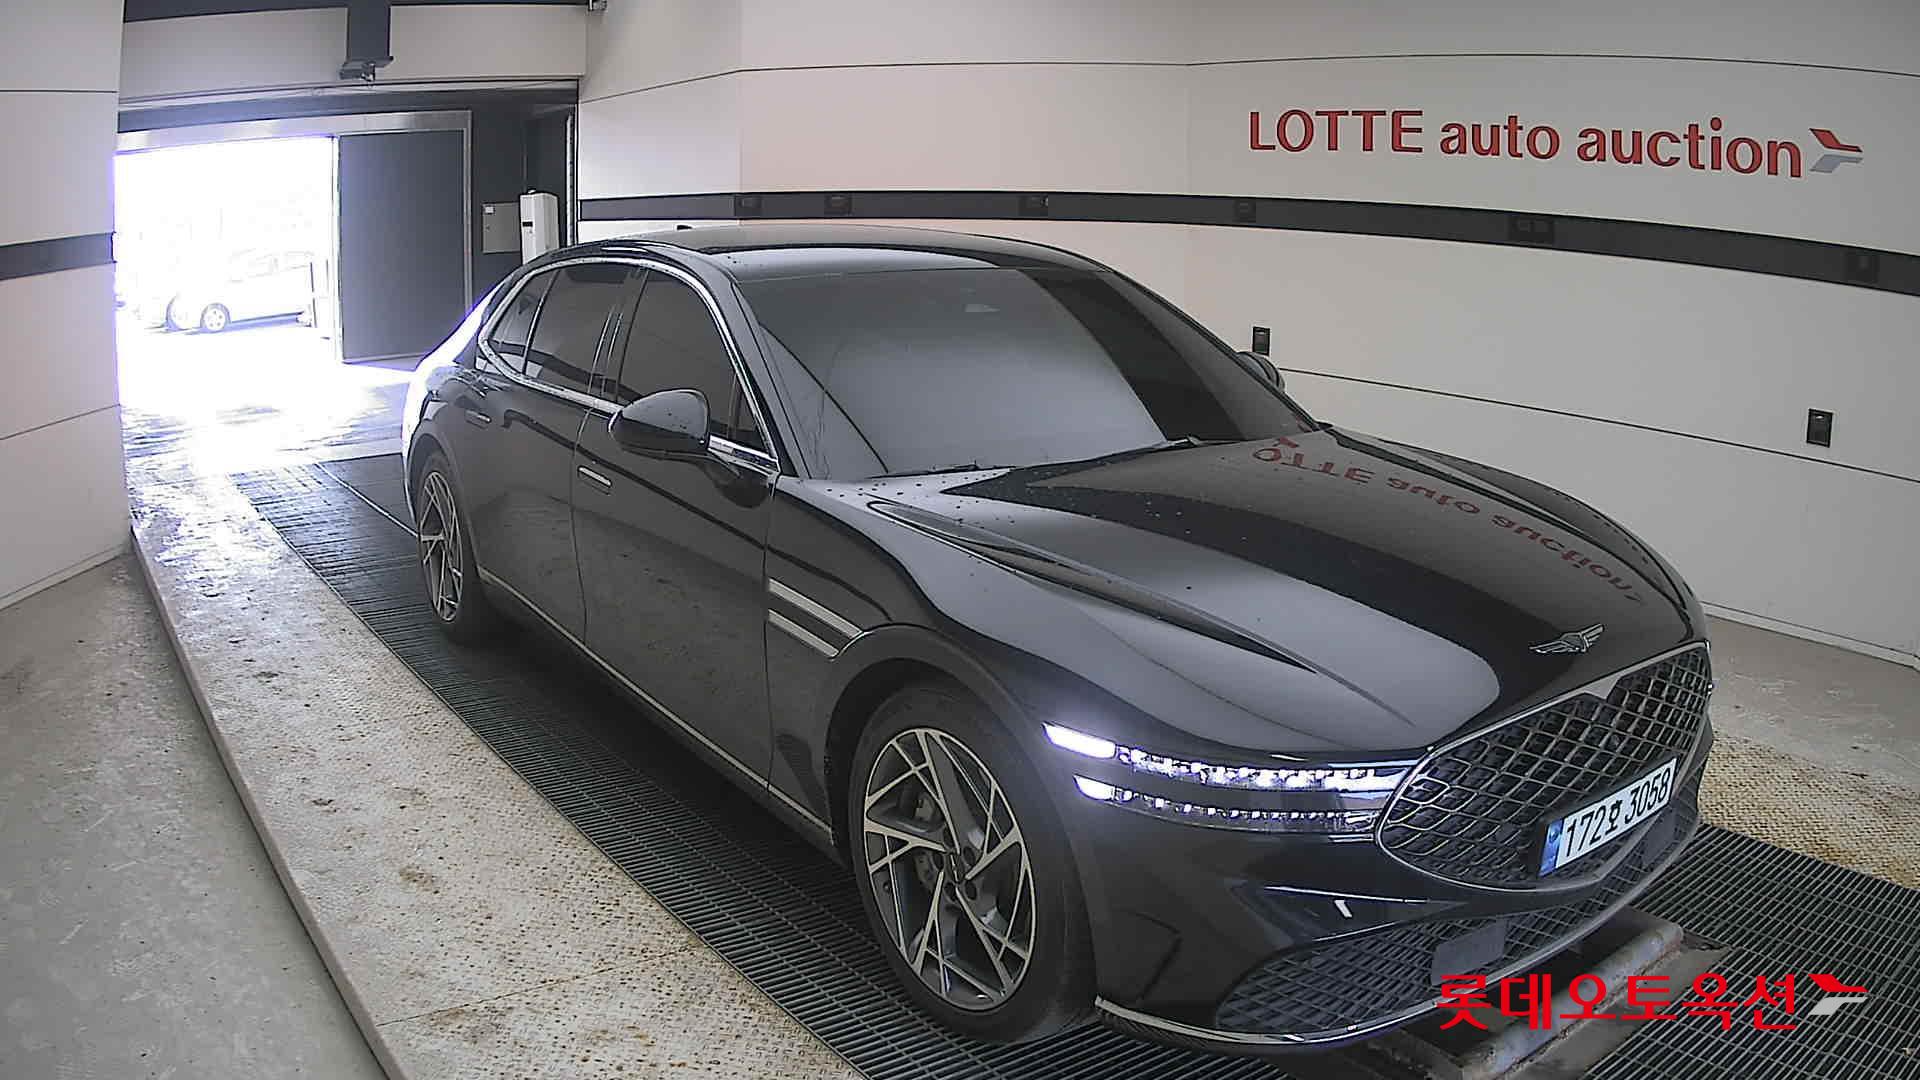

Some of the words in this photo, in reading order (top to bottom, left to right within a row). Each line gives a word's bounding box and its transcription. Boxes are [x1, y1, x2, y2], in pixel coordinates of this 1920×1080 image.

[1248, 109, 1424, 154] LOTTE
[1439, 114, 1560, 161] auto
[1576, 116, 1802, 178] auction
[1624, 767, 1671, 825] 3058
